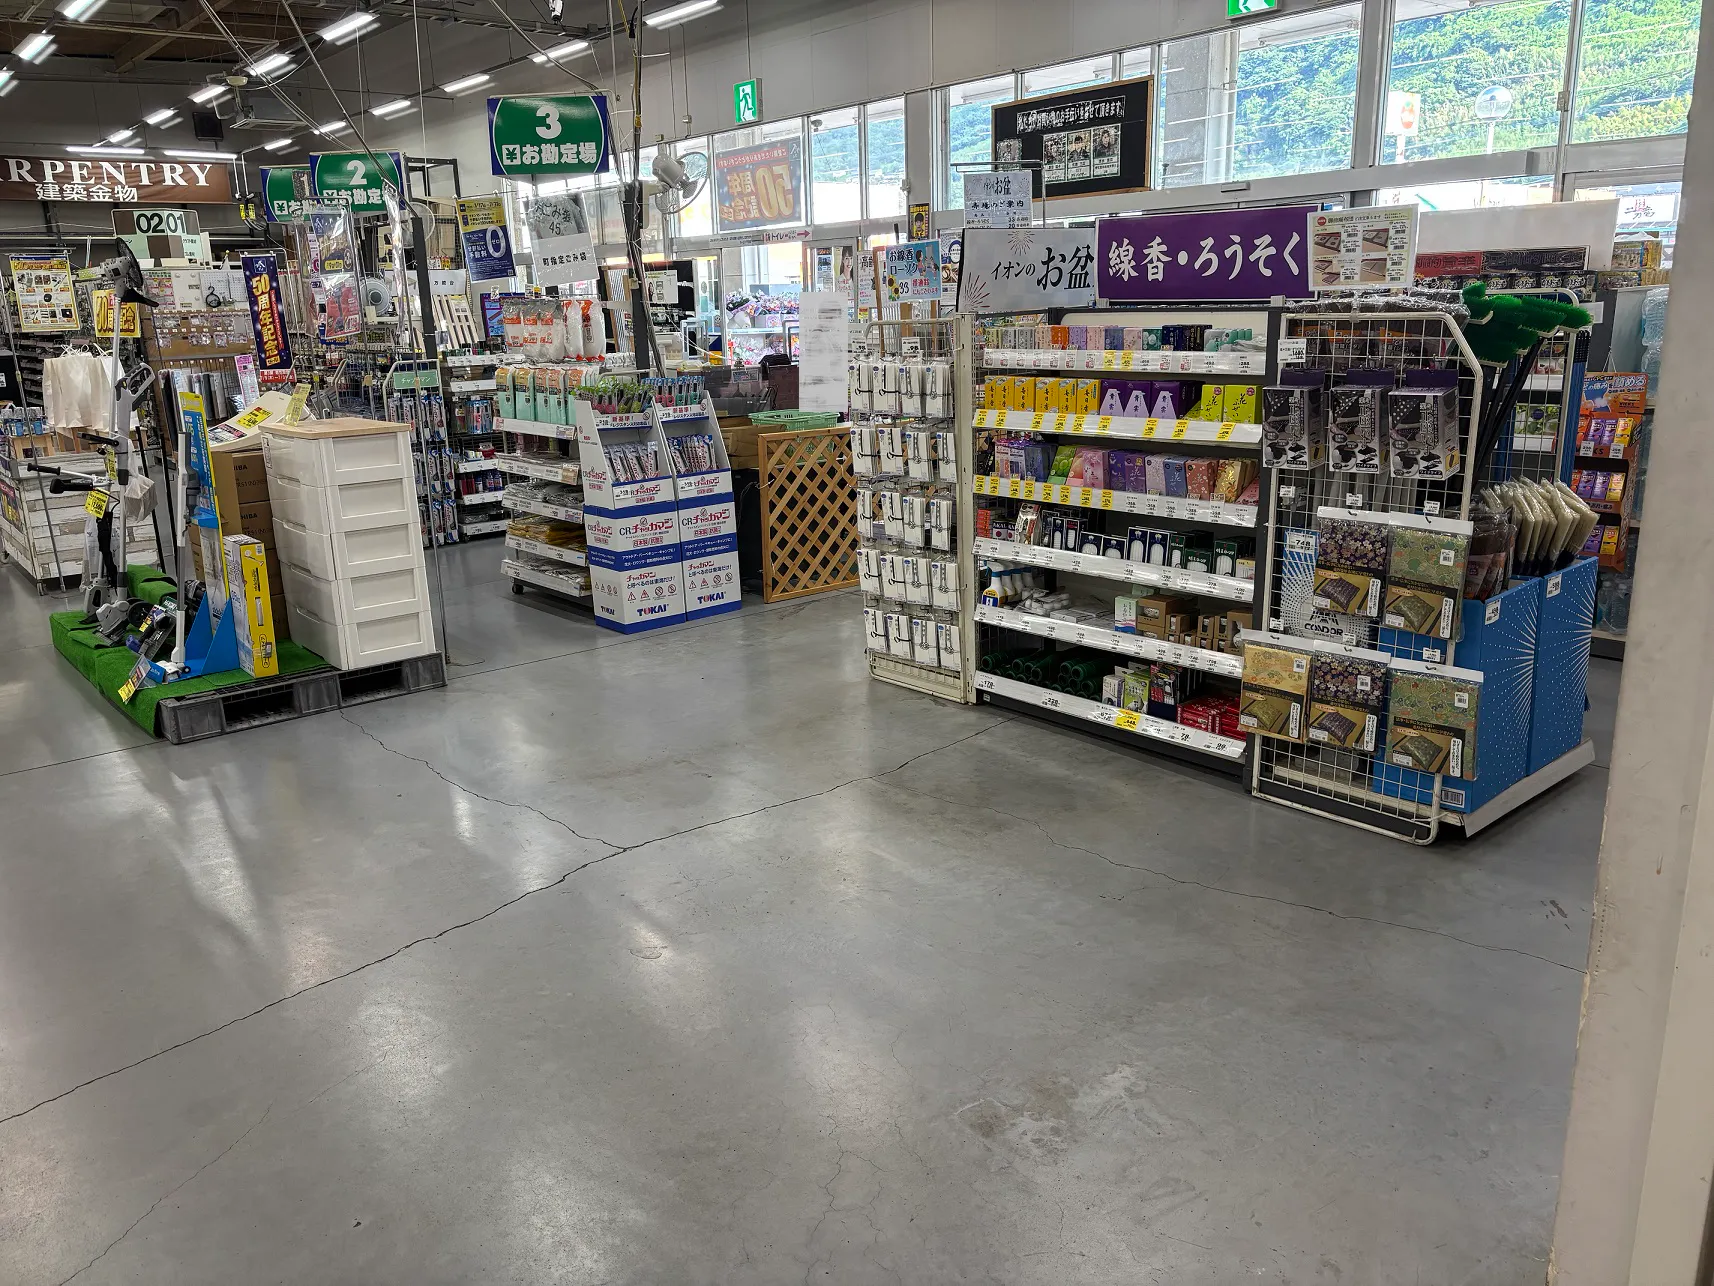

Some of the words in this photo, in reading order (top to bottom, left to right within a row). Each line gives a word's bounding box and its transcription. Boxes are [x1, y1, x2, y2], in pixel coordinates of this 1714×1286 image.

[536, 105, 562, 139] 3
[522, 143, 597, 165] お勘定場
[0, 158, 212, 187] RPENTRY
[347, 160, 367, 185] 2
[35, 182, 138, 202] 建築金物
[889, 248, 915, 263] お線香
[1108, 231, 1300, 282] 線香・ろうそく
[992, 261, 1036, 280] イオンの
[682, 509, 730, 527] CRチャッカマン
[619, 520, 673, 537] CRチャッカマン
[688, 560, 715, 571] チャッカマン
[626, 571, 656, 582] チャッカマン
[697, 592, 725, 604] TOKAI
[637, 603, 668, 617] TOKAI
[1304, 622, 1344, 636] CONDOR
